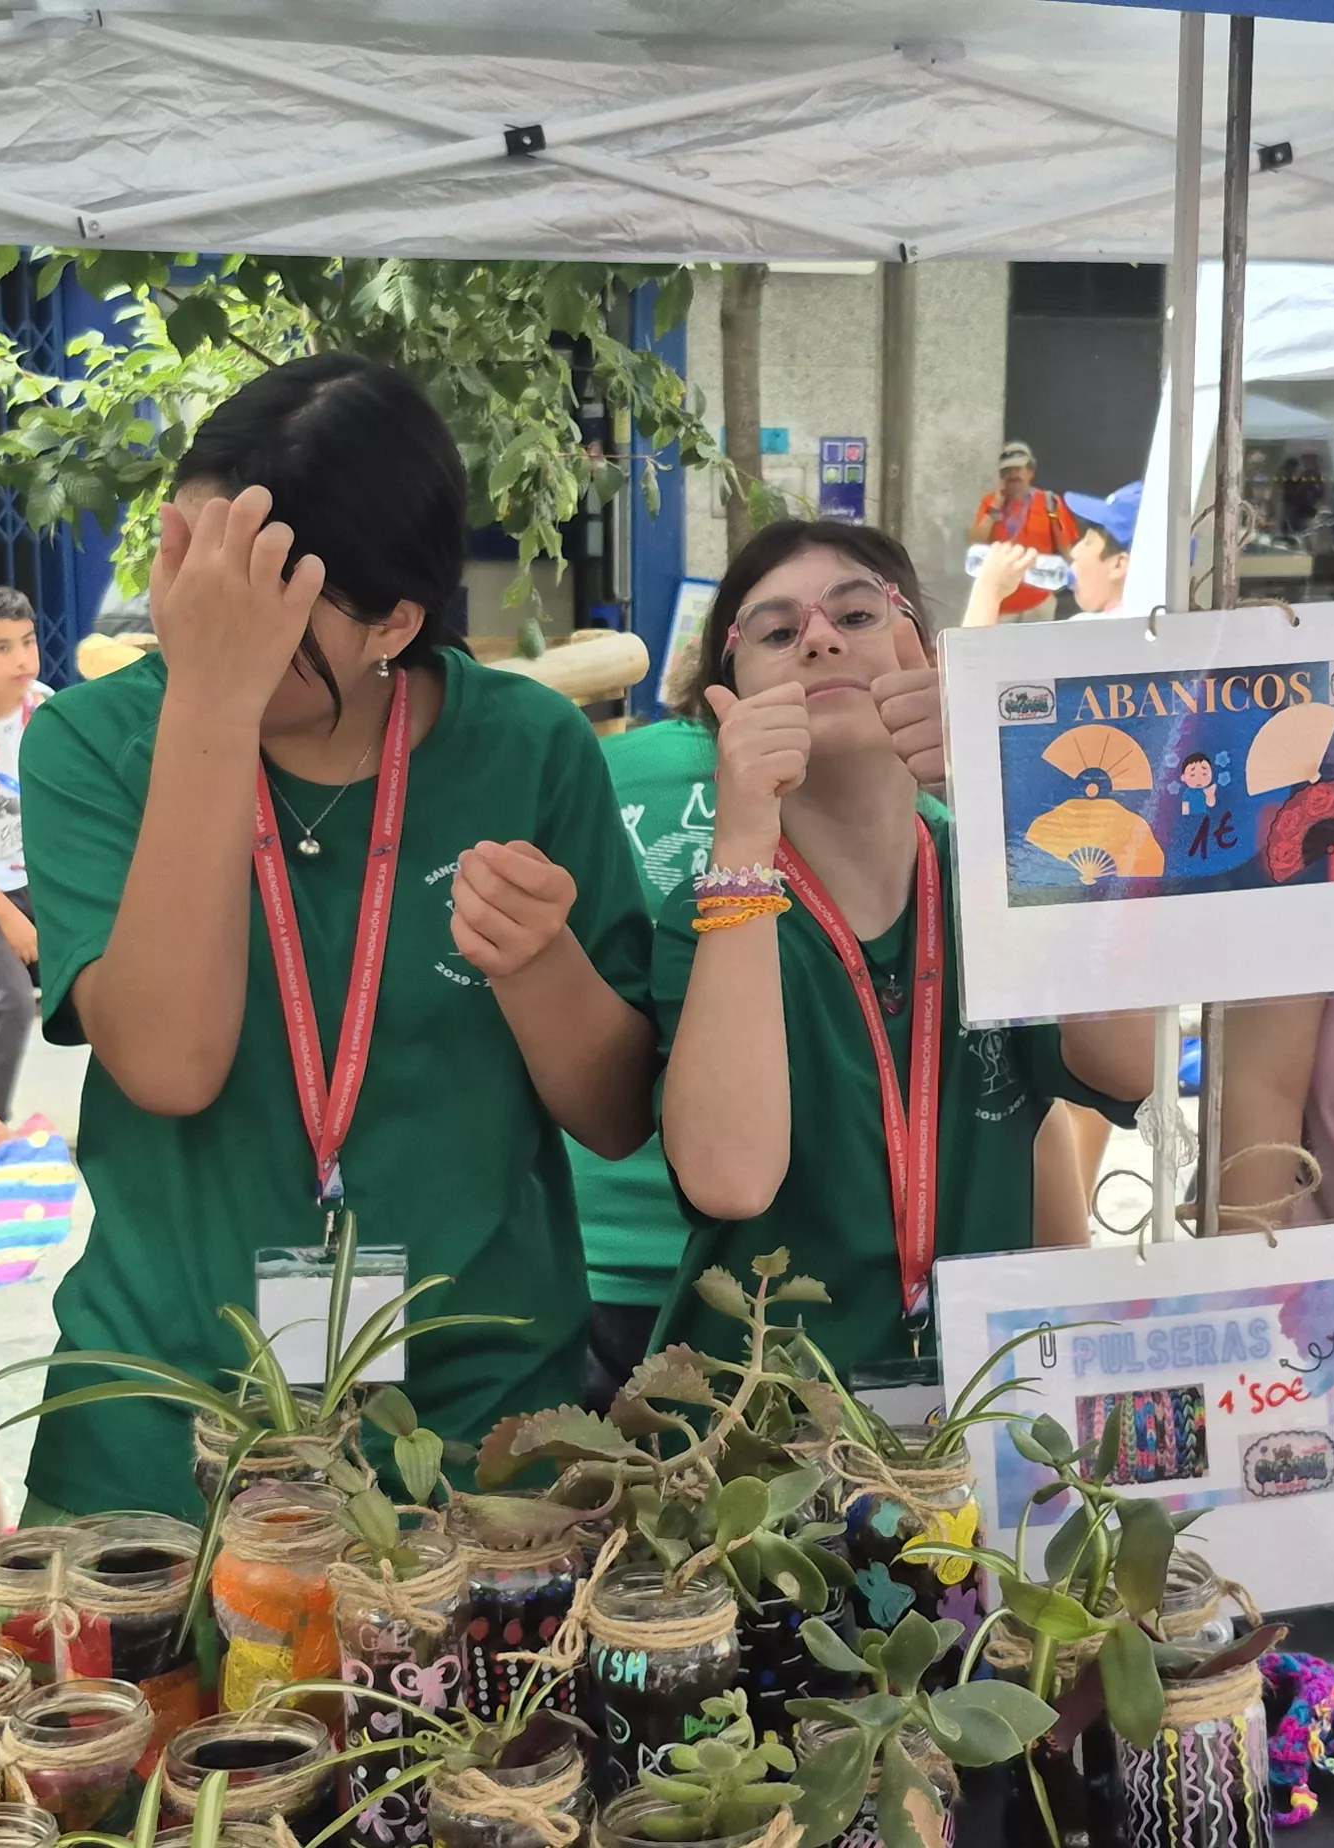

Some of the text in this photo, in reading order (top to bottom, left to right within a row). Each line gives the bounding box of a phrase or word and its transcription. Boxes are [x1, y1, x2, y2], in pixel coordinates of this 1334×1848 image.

[1074, 671, 1313, 722] ABANICOS
[1188, 811, 1239, 860] 1€
[434, 961, 472, 986] 2019
[1072, 1317, 1273, 1378] PULSERAS
